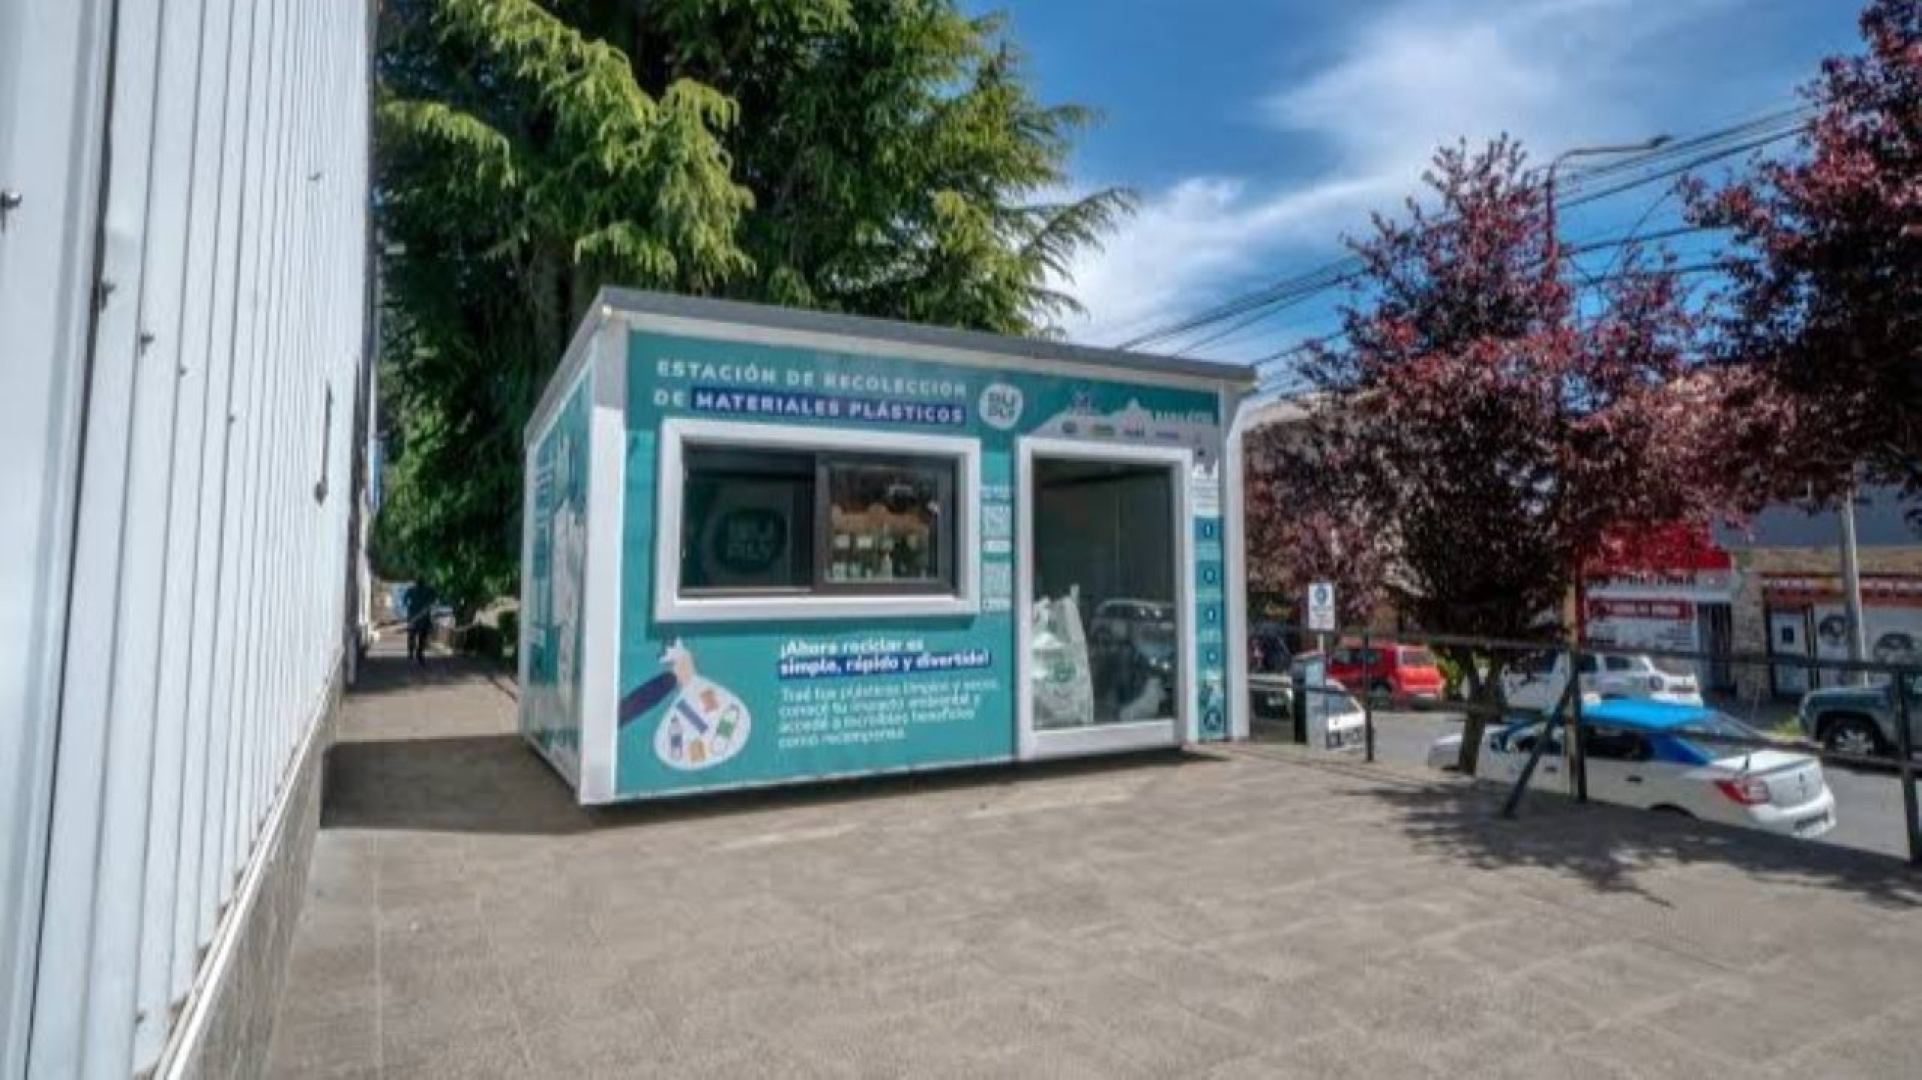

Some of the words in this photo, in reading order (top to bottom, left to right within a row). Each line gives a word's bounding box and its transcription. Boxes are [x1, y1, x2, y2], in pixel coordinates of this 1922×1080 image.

[656, 360, 776, 386] ESTACIÓN
[786, 369, 813, 388] DE
[654, 389, 685, 407] DE
[695, 394, 840, 417] MATERIALES
[850, 402, 963, 424] PLÁSTICOS
[843, 637, 901, 654] reciclar
[906, 637, 924, 651] es
[846, 653, 899, 675] rápido
[904, 656, 913, 671] y
